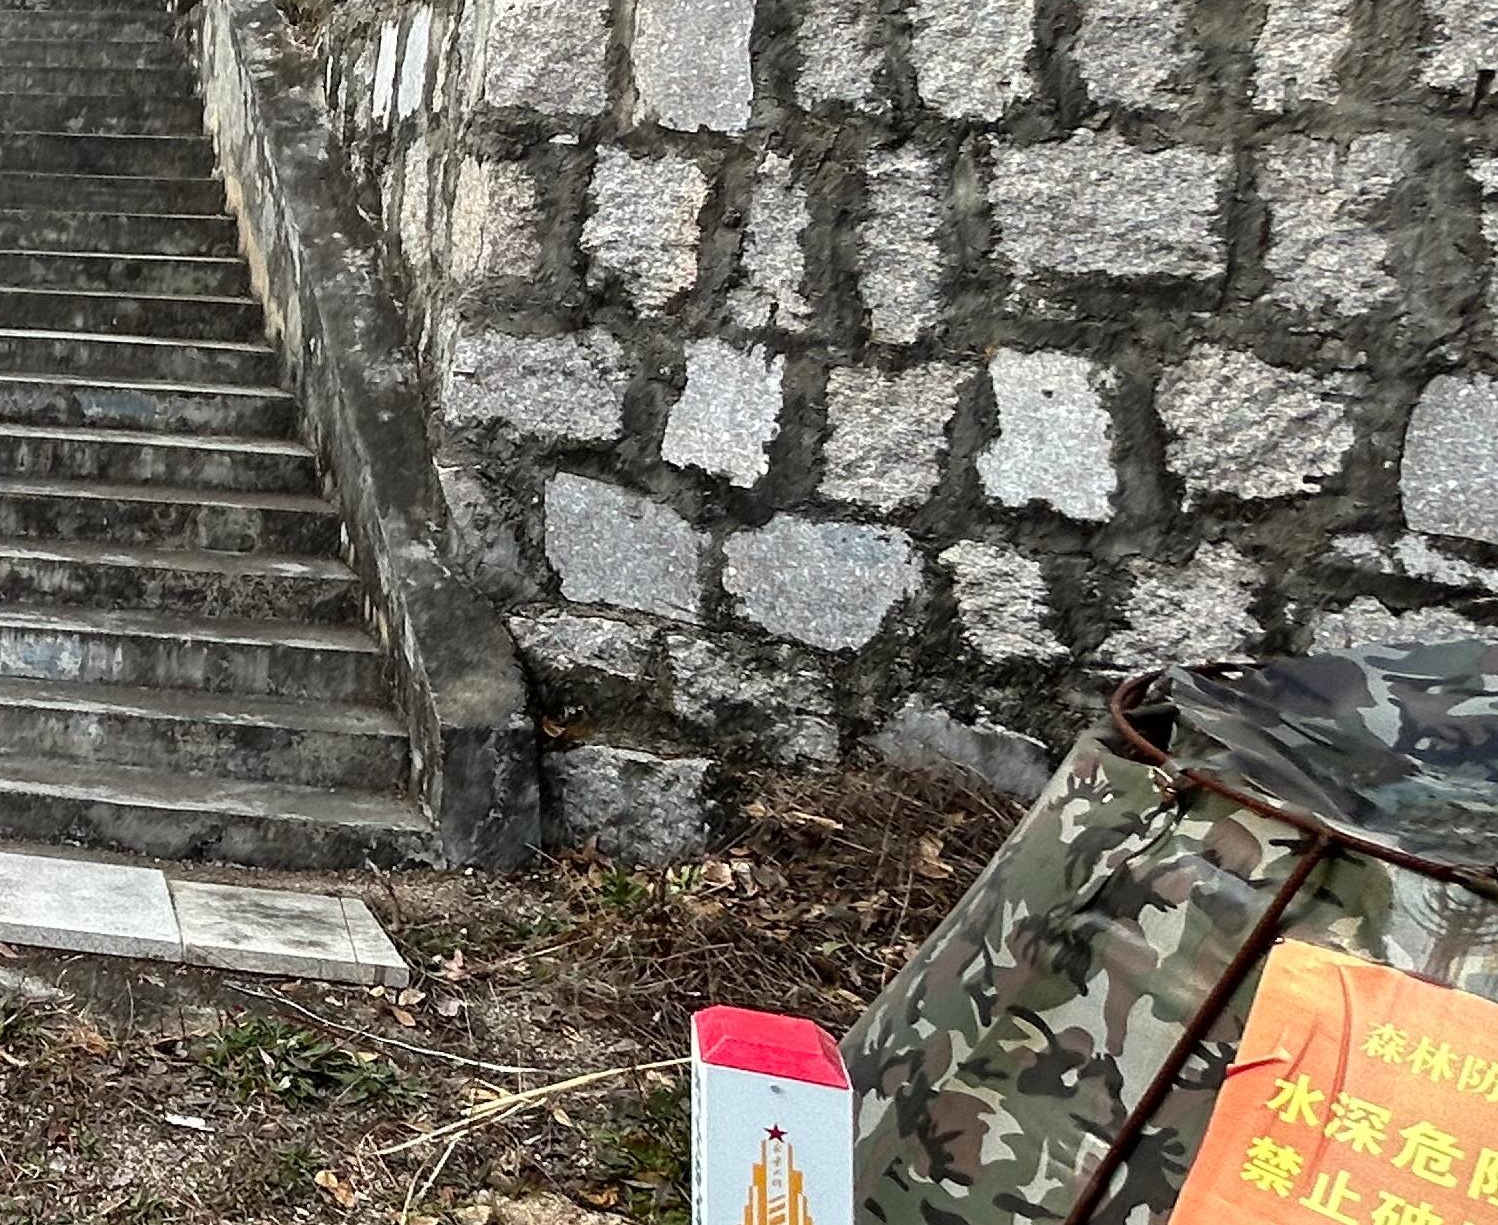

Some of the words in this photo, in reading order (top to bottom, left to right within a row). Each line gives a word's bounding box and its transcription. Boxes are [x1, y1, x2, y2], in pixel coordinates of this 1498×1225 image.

[1359, 1022, 1498, 1103] 森林防
[1240, 1136, 1477, 1225] 禁止破
